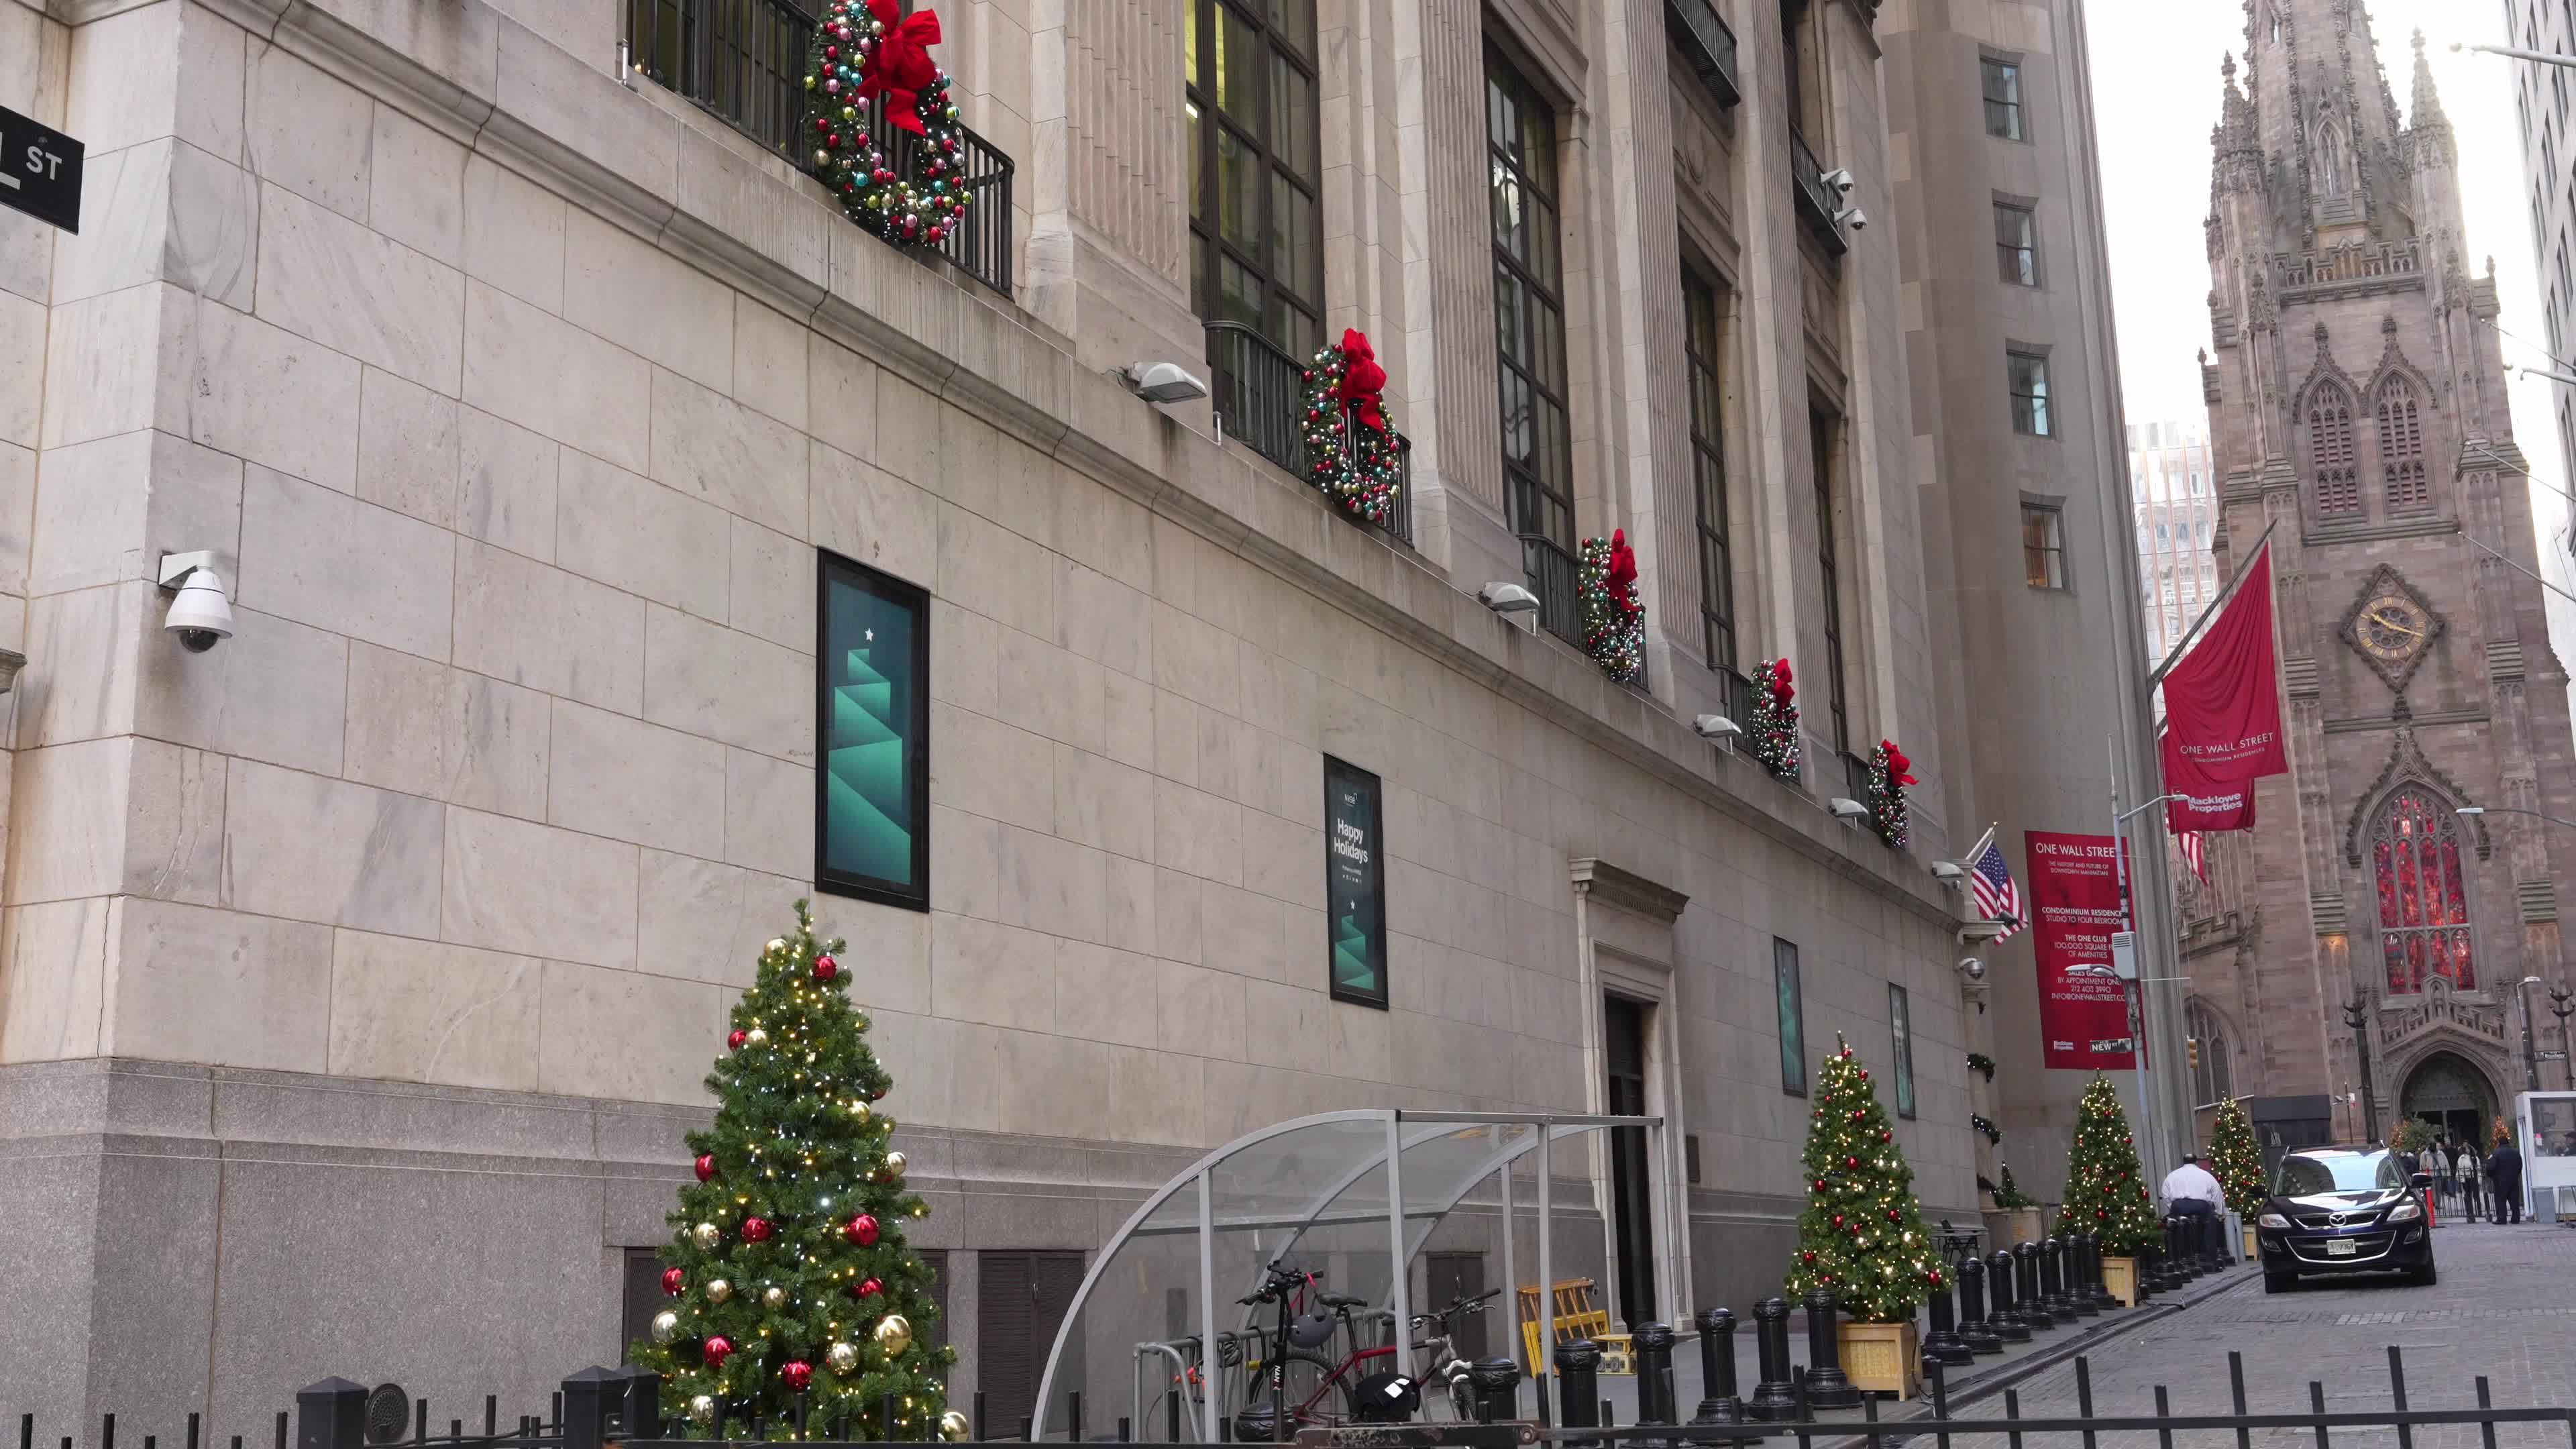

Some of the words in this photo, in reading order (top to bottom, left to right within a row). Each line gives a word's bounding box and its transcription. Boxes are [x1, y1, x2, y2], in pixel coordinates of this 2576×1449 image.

[25, 146, 62, 180] ST
[2180, 745, 2202, 754] ONE
[2206, 742, 2236, 754] WALL
[2240, 732, 2273, 749] STREET
[2188, 793, 2241, 805] Macklowe
[2189, 800, 2243, 813] Properties
[1338, 818, 1363, 845] Happy
[1334, 837, 1368, 864] Holidays
[2036, 843, 2057, 855] ONE
[2059, 844, 2084, 857] WALL
[2042, 906, 2090, 916] CONDOMINIUM
[2046, 914, 2067, 922] STUDIO
[2065, 934, 2076, 942] THE
[2077, 934, 2091, 943] ONE
[2054, 942, 2083, 950] 100,000
[2078, 951, 2108, 959] AMENITIES
[2065, 977, 2105, 985] APPOINTMENT
[2092, 1042, 2111, 1051] NEW
